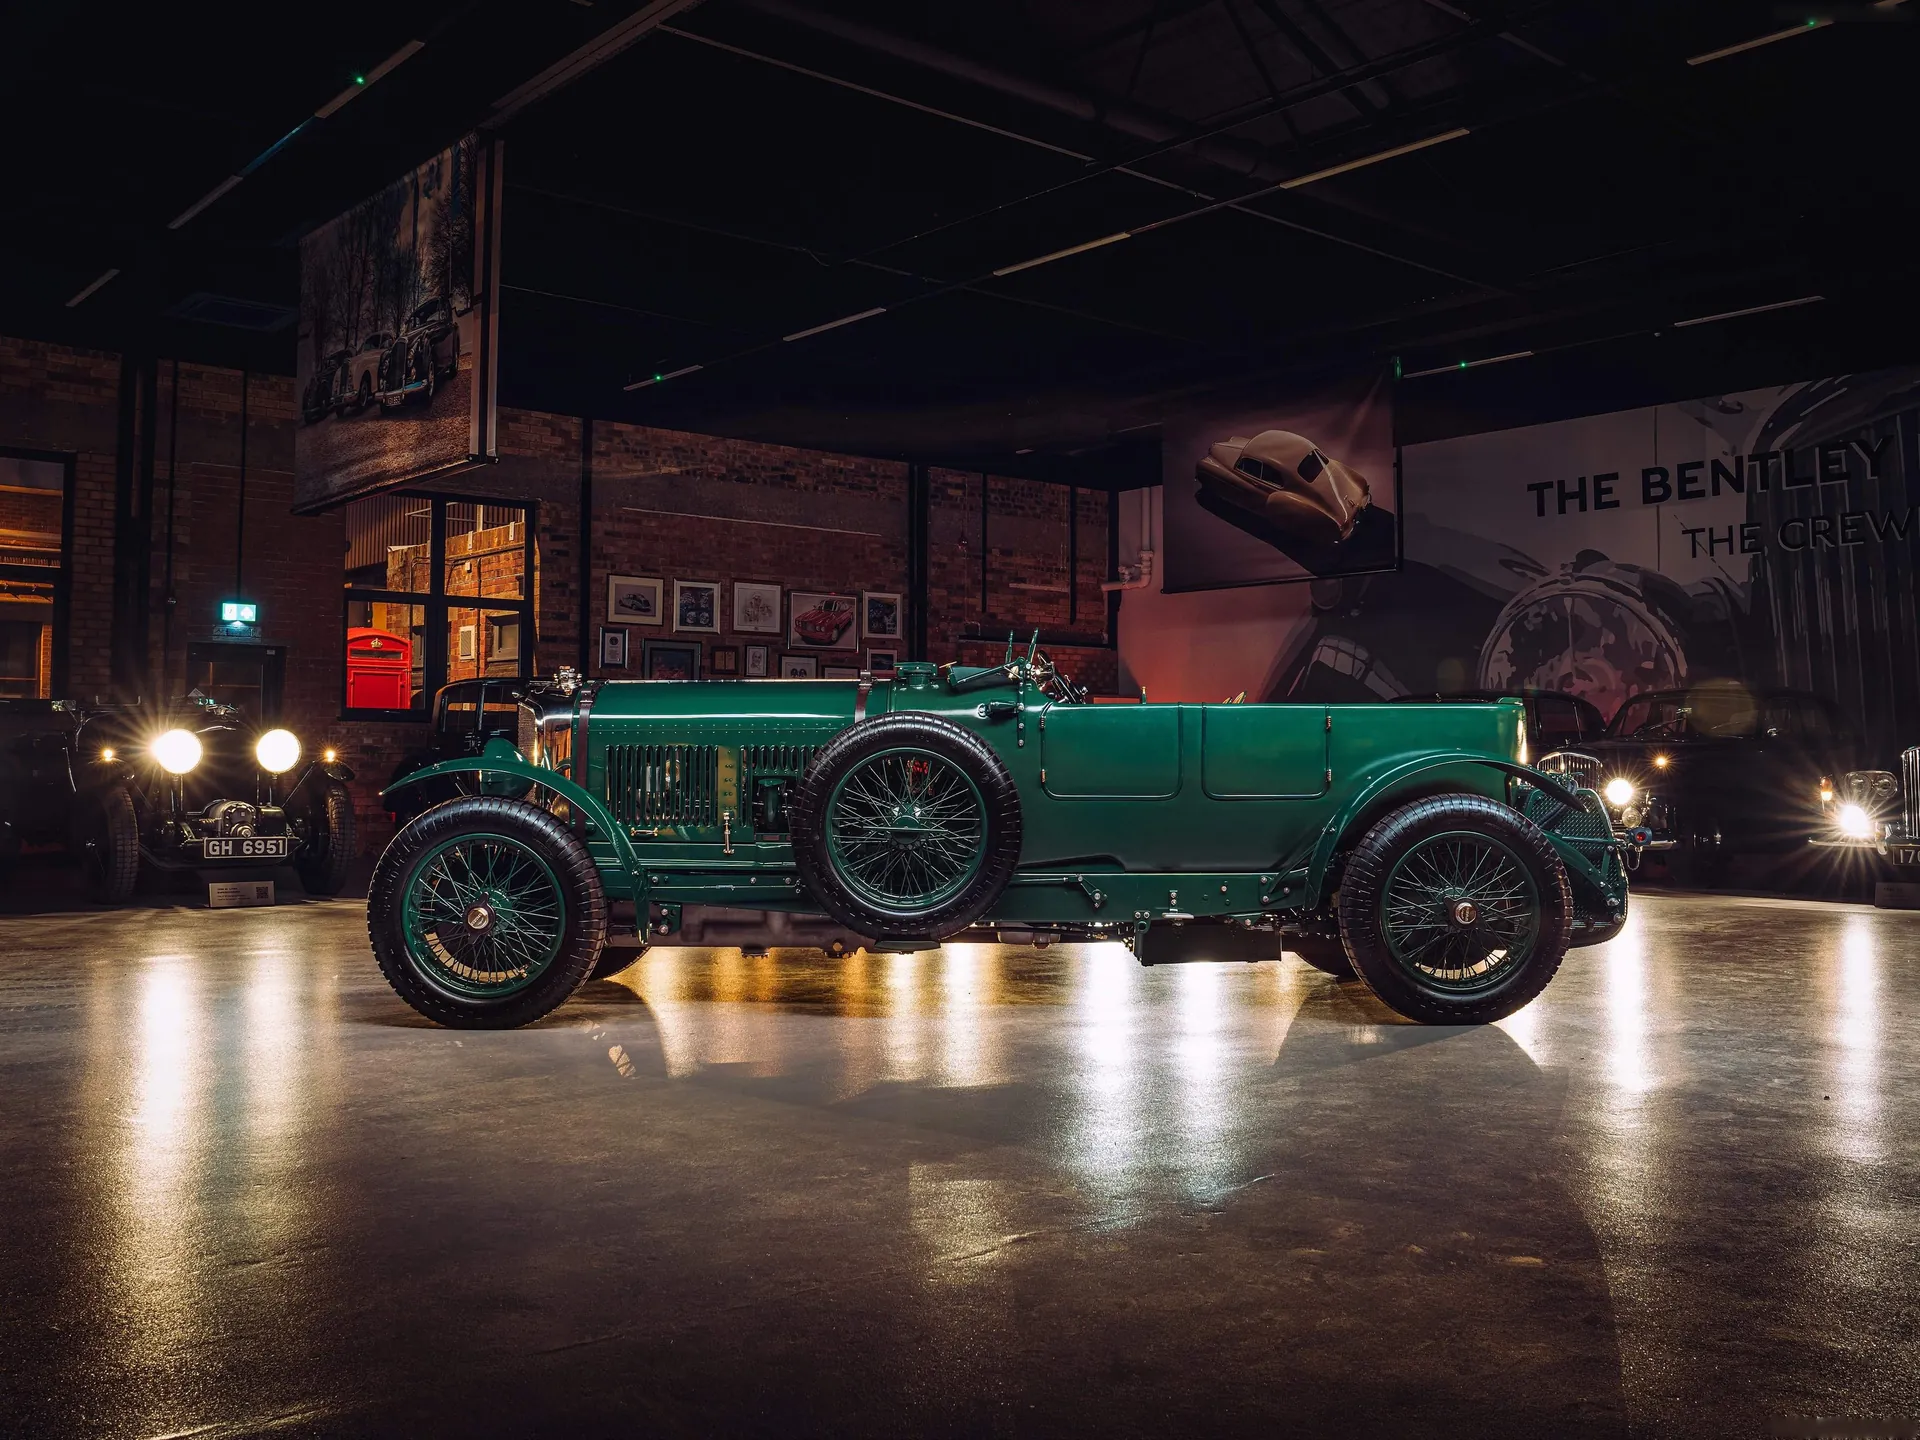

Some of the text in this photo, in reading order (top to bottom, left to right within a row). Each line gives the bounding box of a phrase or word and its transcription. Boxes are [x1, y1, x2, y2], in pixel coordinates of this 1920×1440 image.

[1526, 435, 1894, 517] THE BENTLEY
[1681, 507, 1914, 559] THE CREW
[208, 839, 284, 856] GH 6951
